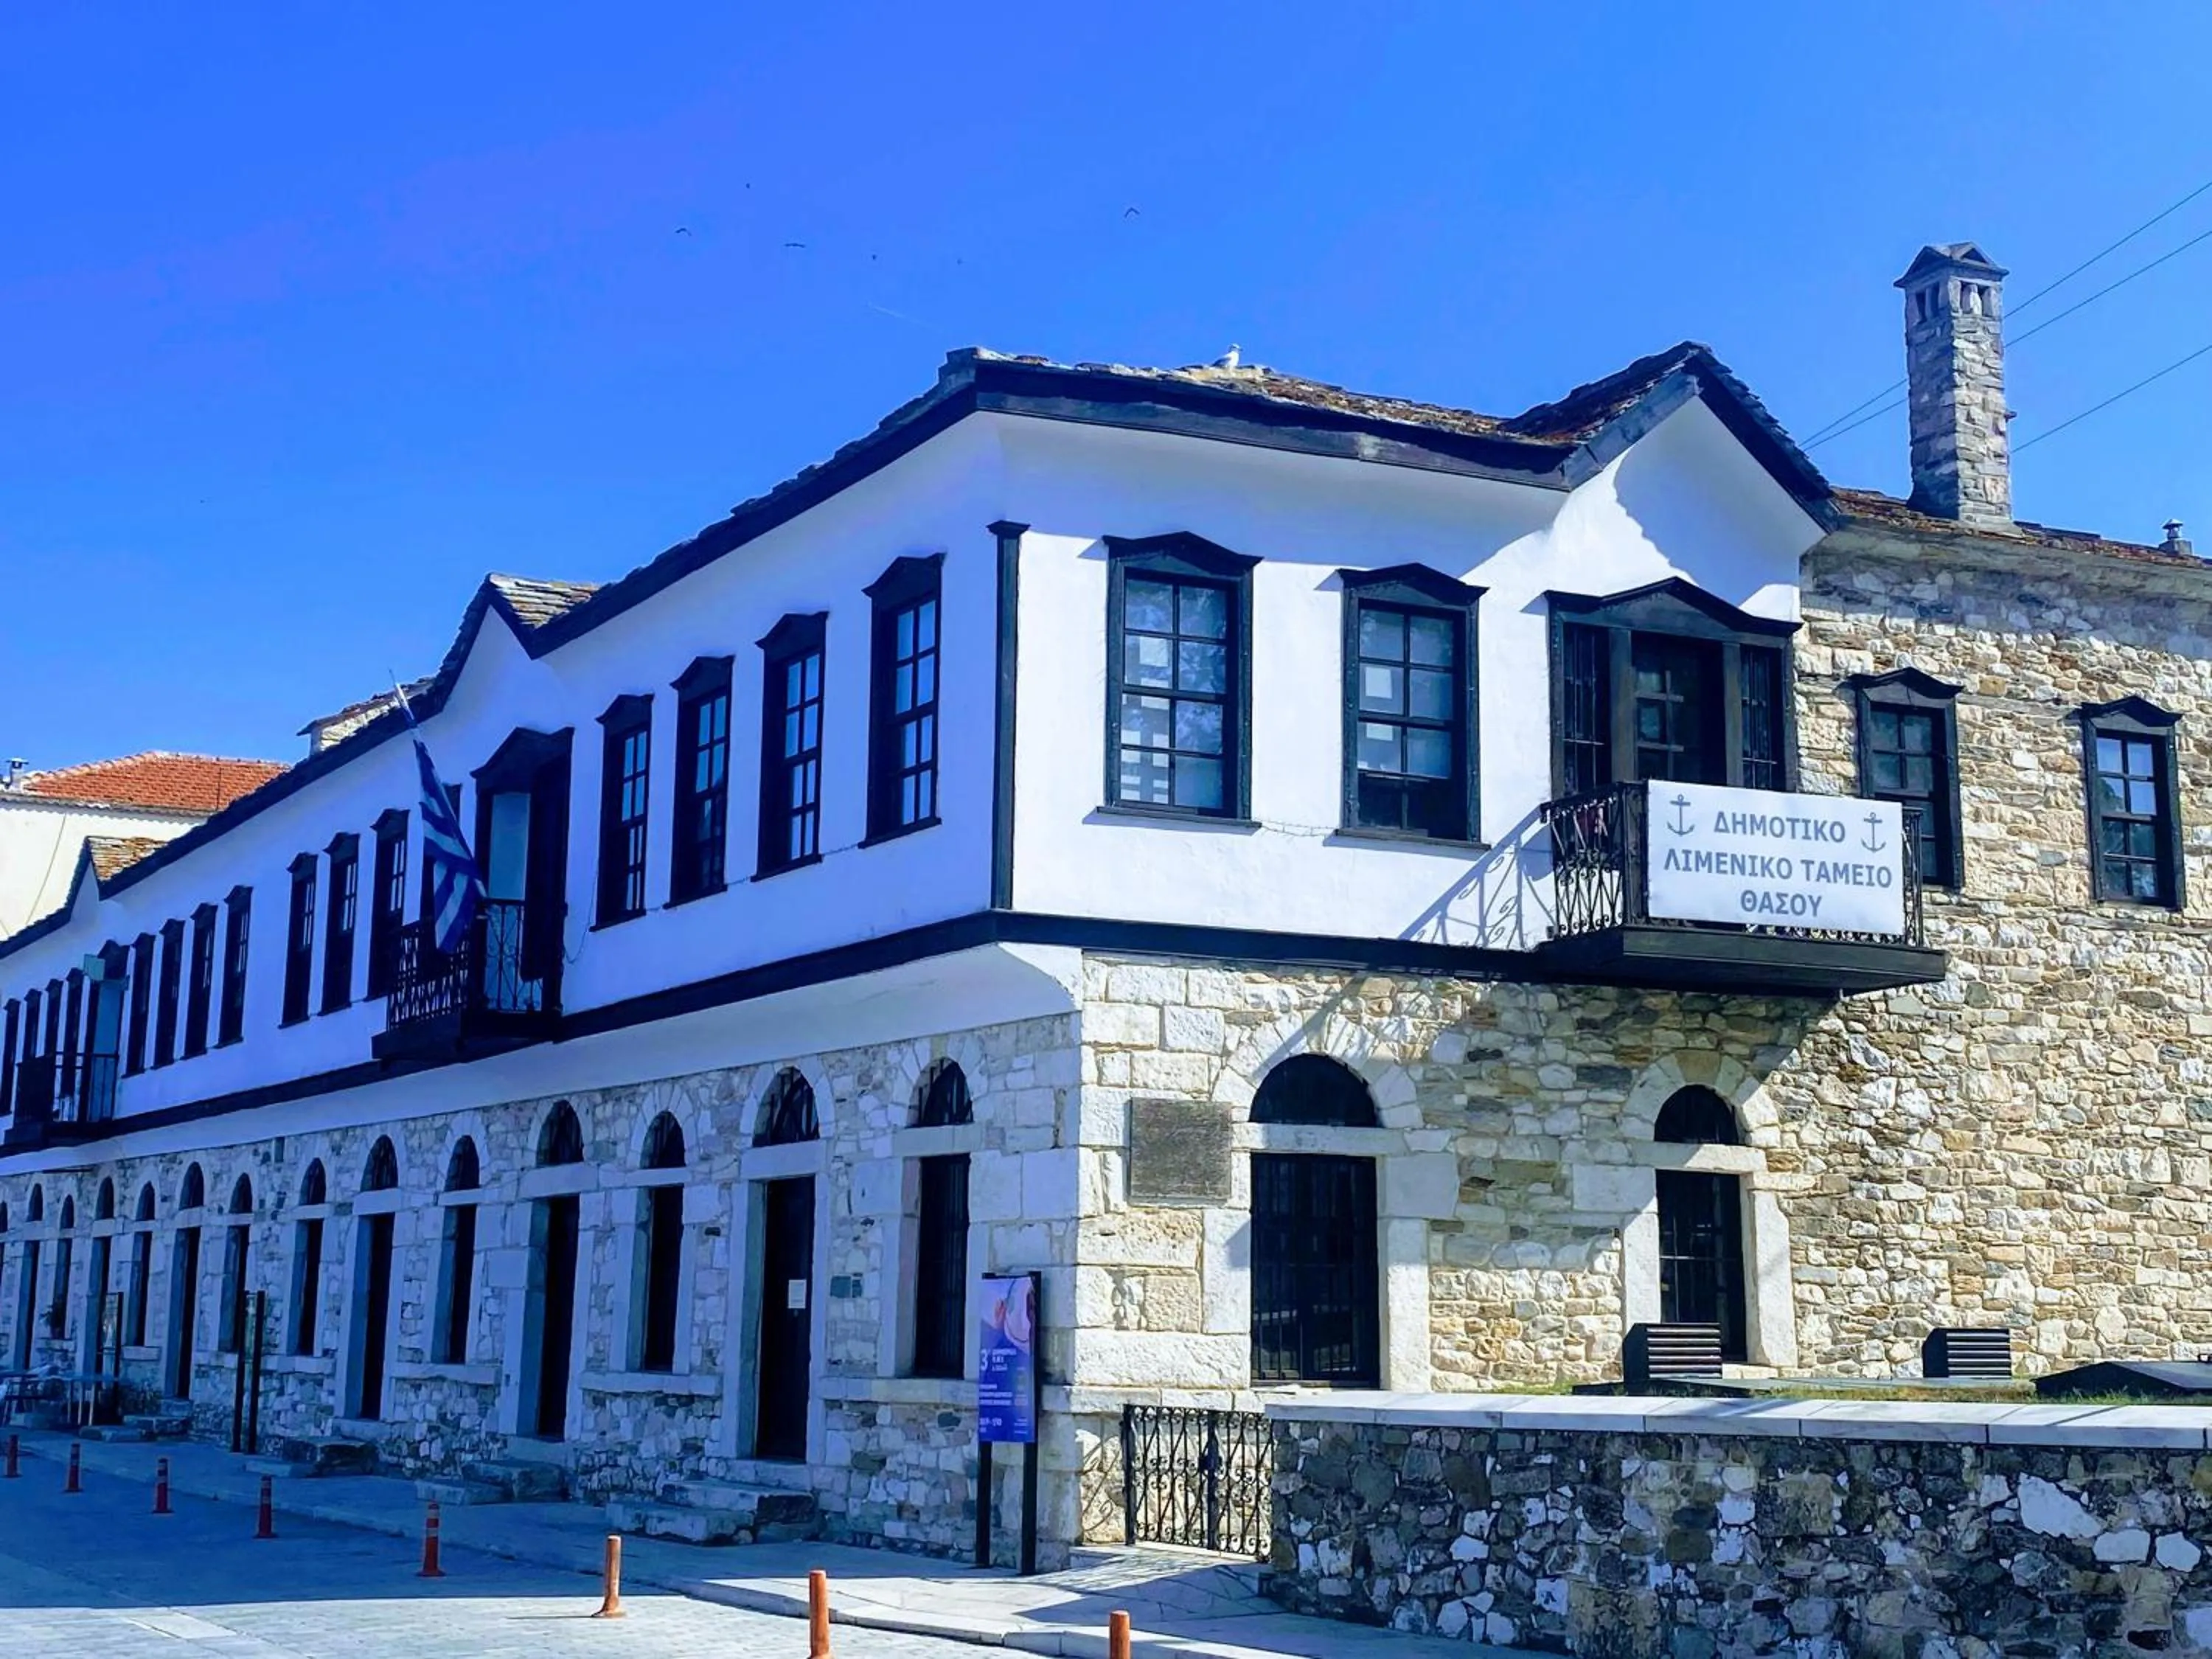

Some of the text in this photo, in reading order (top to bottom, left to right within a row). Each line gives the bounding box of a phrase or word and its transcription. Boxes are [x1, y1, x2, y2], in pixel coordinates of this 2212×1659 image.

[1714, 811, 1845, 843] ΔΗΜΟΤΙΚΟ
[1663, 849, 1892, 888] ΛΙΜΕΝΙΚΟ ΤΑΜΕΙΟ
[1740, 890, 1823, 917] ΘΑΣΟΥ
